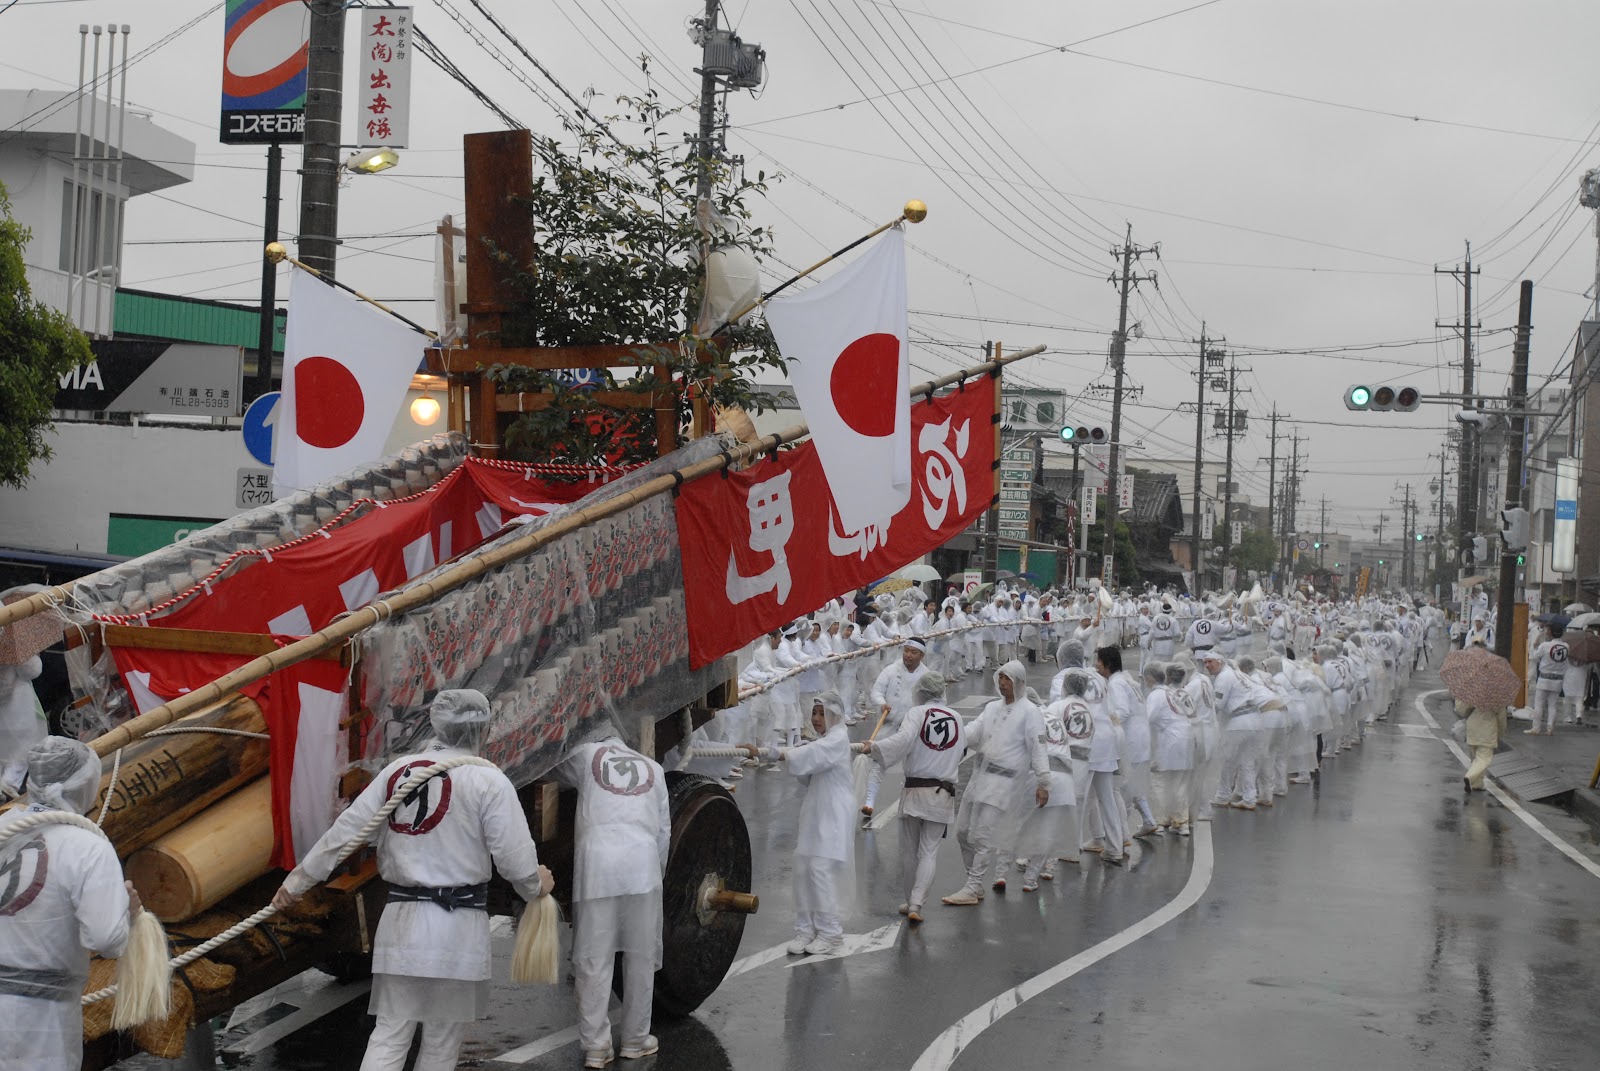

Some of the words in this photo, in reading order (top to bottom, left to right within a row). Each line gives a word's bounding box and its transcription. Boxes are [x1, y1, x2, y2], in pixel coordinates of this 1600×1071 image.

[396, 15, 406, 60] 伊勢名物
[229, 114, 305, 134] コスモ石油
[243, 474, 268, 488] 大型
